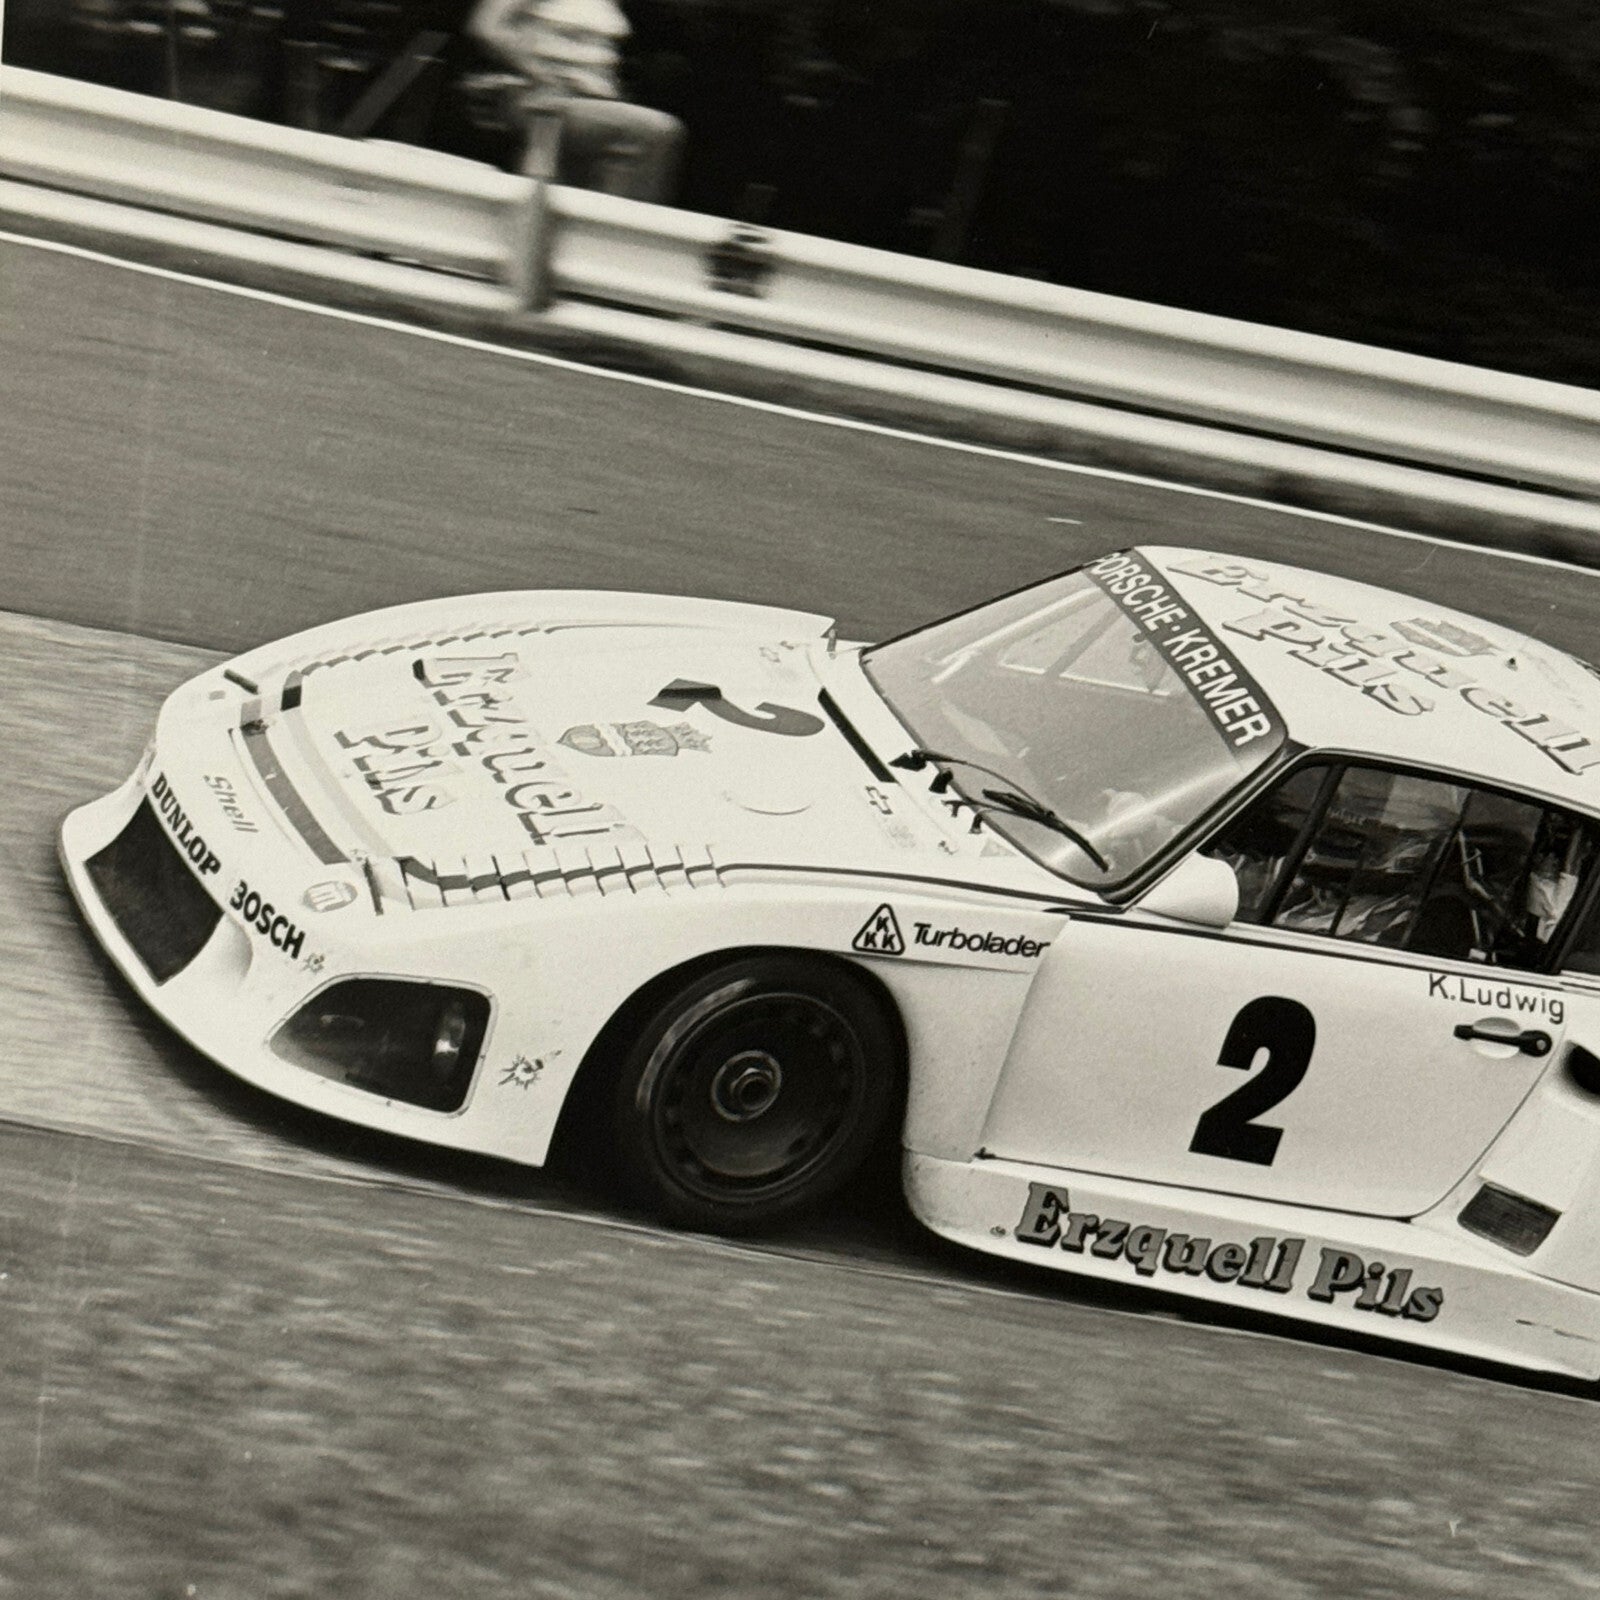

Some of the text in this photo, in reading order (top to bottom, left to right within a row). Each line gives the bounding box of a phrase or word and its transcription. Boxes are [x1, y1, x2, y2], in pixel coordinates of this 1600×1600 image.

[646, 677, 826, 737] 2
[1221, 608, 1435, 717] Pils
[151, 771, 222, 876] DUNLOP
[203, 774, 259, 833] Shell
[913, 922, 1051, 958] Turbolader
[1188, 995, 1317, 1167] 2
[1013, 1181, 1444, 1322] Erzquell Pils
